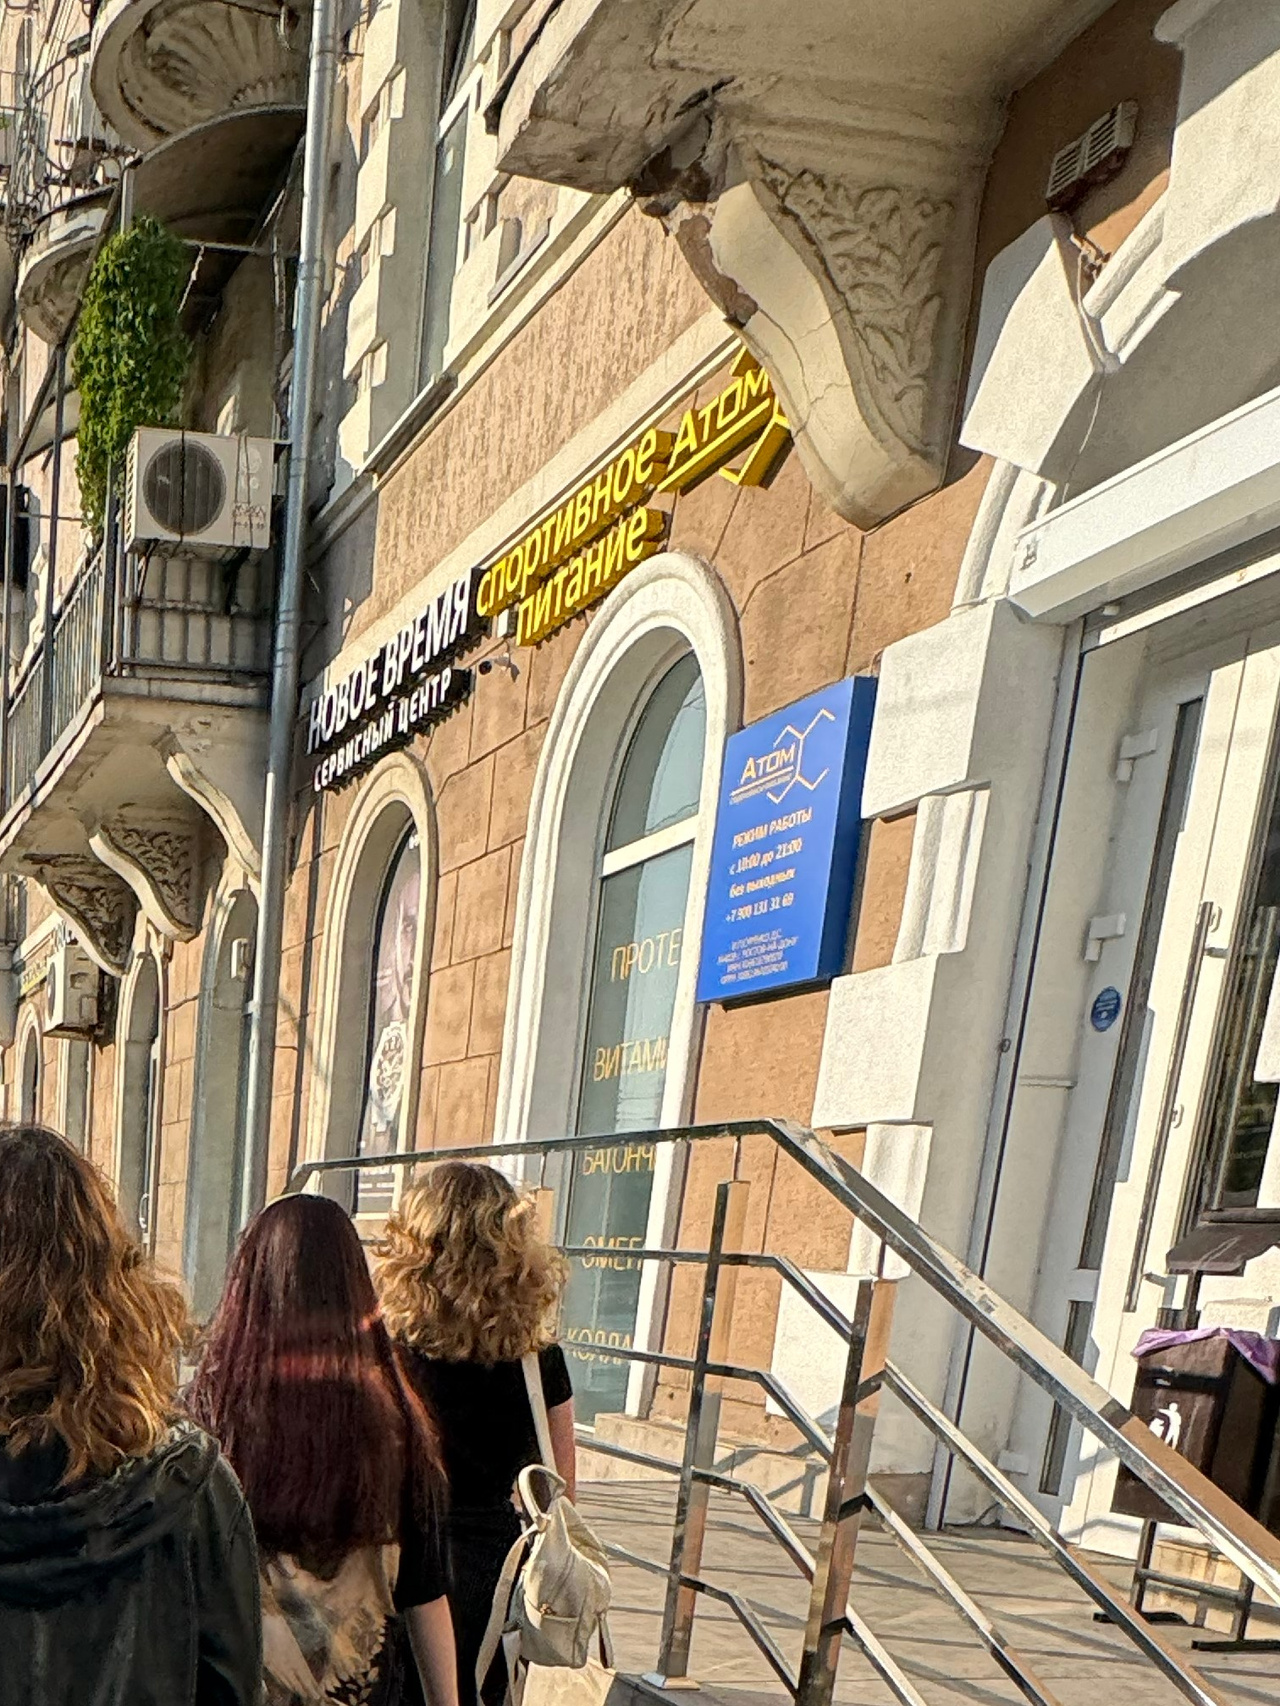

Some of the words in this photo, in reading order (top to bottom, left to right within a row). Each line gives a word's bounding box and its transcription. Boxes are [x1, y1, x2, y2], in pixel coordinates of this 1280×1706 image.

[516, 506, 648, 646] питание
[306, 652, 379, 755] НОВОЕ
[381, 570, 472, 697] ВРЕМЯ
[314, 702, 395, 793] СЕРВИСНЫЙ
[397, 666, 452, 733] ЦЕНТР
[732, 823, 768, 850] РЕЖИМ
[769, 806, 813, 836] РАБОТЫ
[761, 850, 775, 868] до
[729, 883, 745, 899] без
[611, 928, 682, 983] ПРОТЕ
